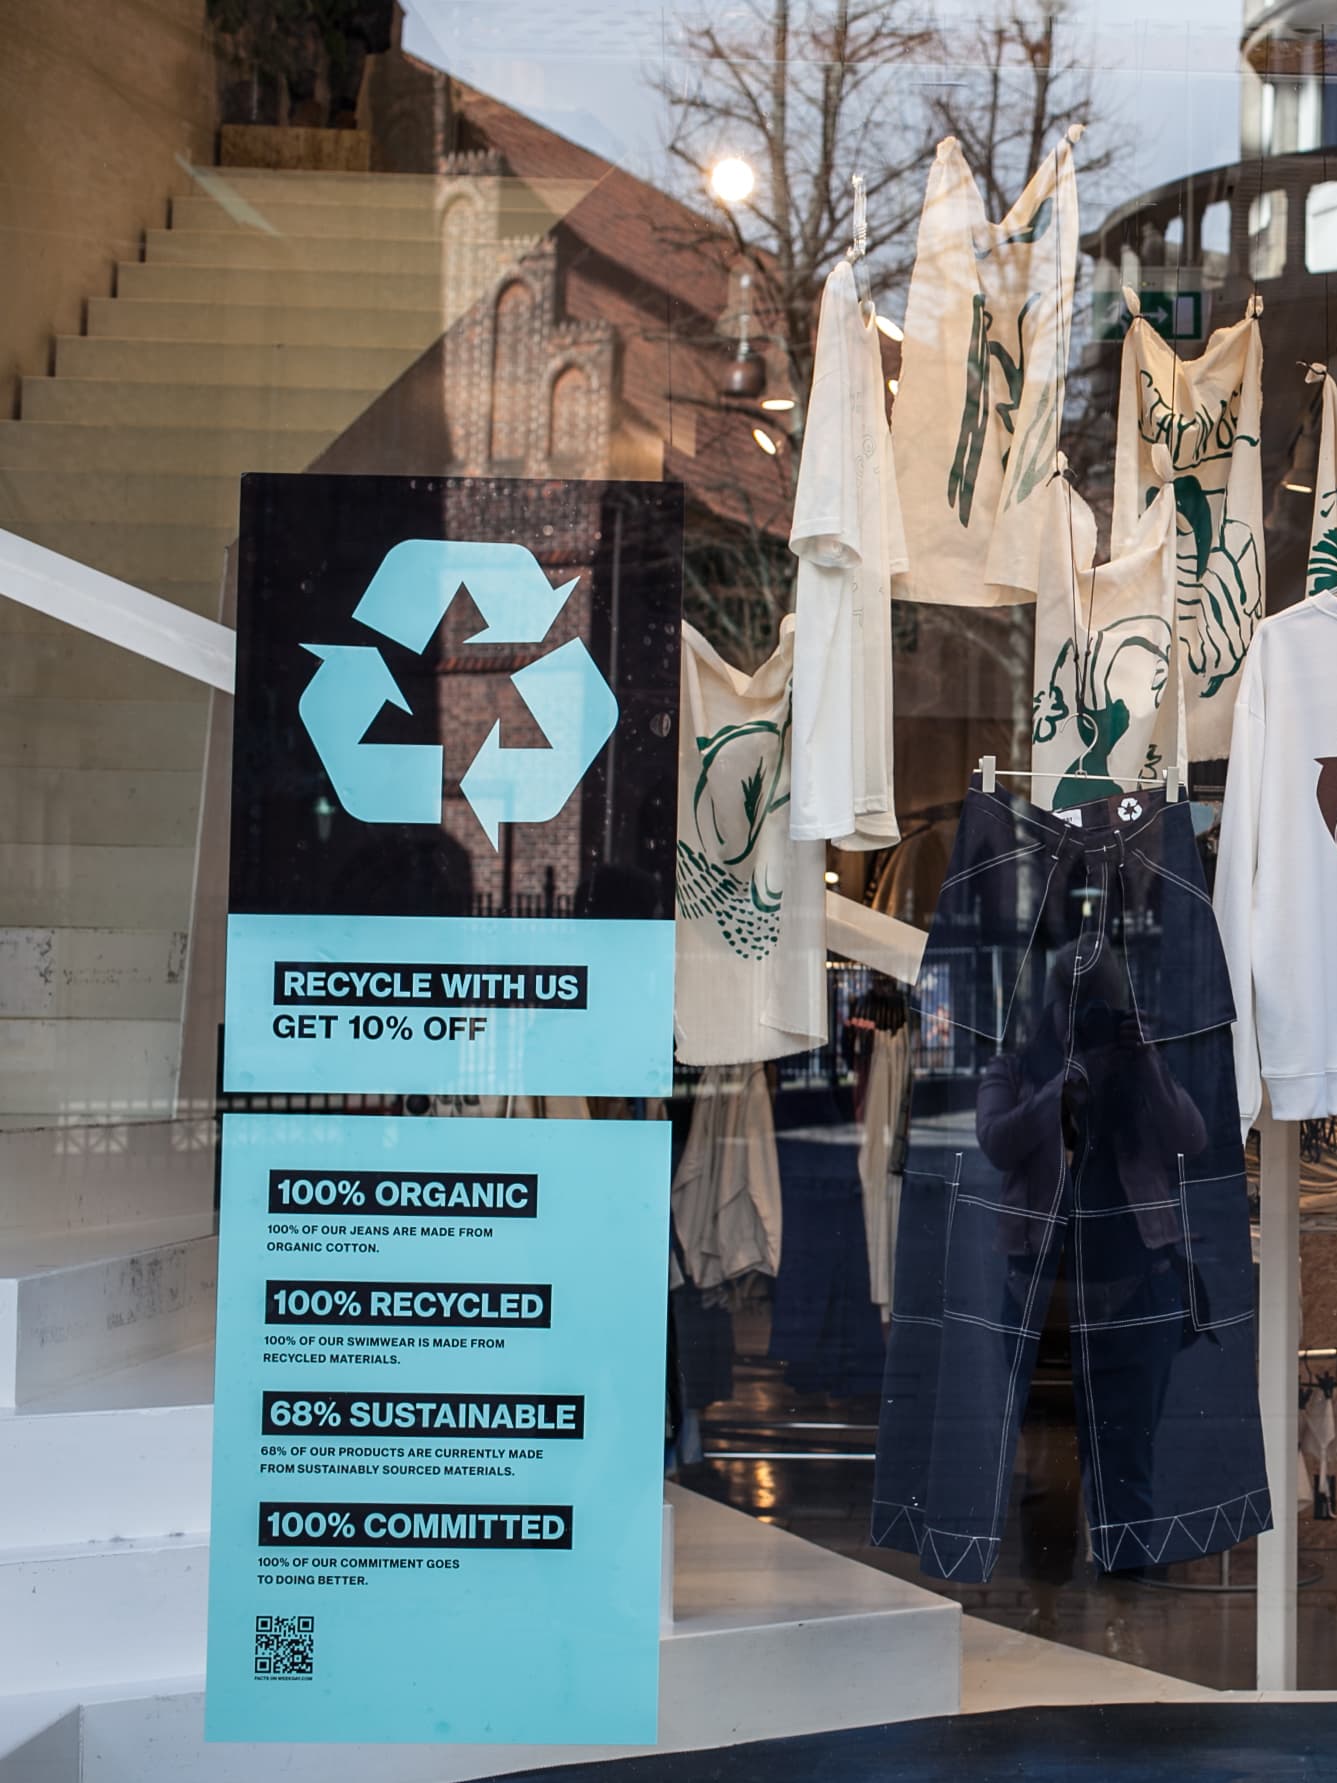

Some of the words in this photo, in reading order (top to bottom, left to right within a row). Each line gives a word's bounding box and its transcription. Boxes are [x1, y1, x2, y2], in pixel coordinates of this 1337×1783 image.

[284, 971, 431, 997] RECYCLE
[441, 974, 524, 999] WITH
[536, 975, 578, 1000] US
[273, 1015, 338, 1038] GET
[349, 1016, 412, 1040] 10%
[424, 1017, 487, 1040] OFF
[278, 1180, 365, 1205] 100%
[376, 1181, 528, 1208] ORGANIC
[267, 1224, 300, 1235] 100%
[301, 1224, 319, 1235] OF
[320, 1225, 347, 1236] OUR
[349, 1225, 390, 1236] JEANS
[392, 1226, 417, 1237] ARE
[420, 1226, 455, 1237] MADE
[458, 1227, 493, 1238] FROM
[266, 1241, 323, 1253] ORGANIC
[325, 1242, 380, 1253] COTTON.
[274, 1290, 361, 1316] 100%
[371, 1292, 543, 1318] RECYCLED
[264, 1335, 297, 1346] 100%
[298, 1335, 316, 1346] OF
[318, 1336, 344, 1346] OUR
[346, 1336, 416, 1348] SWIMWEAR
[418, 1337, 430, 1348] IS
[432, 1337, 468, 1348] MADE
[470, 1338, 505, 1349] FROM
[263, 1352, 327, 1364] RECYCLED
[329, 1353, 401, 1365] MATERIALS.
[271, 1401, 341, 1426] 68%
[350, 1402, 576, 1429] SUSTAINABLE
[260, 1445, 287, 1457] 68%
[290, 1446, 307, 1457] OF
[309, 1446, 336, 1457] OUR
[338, 1446, 405, 1458] PRODUCTS
[407, 1447, 433, 1458] ARE
[434, 1448, 506, 1459] CURRENTLY
[508, 1449, 544, 1460] MADE
[259, 1463, 295, 1474] FROM
[297, 1463, 380, 1475] SUSTAINABLY
[382, 1464, 441, 1476] SOURCED
[443, 1465, 515, 1477] MATERIALS.
[268, 1512, 355, 1537] 100%
[364, 1513, 564, 1539] COMMITTED
[257, 1557, 290, 1568] 100%
[292, 1557, 309, 1568] OF
[311, 1557, 338, 1568] OUR
[340, 1557, 424, 1569] COMMITMENT
[426, 1559, 460, 1569] GOES
[256, 1574, 274, 1585] TO
[275, 1575, 315, 1585] DOING
[317, 1575, 369, 1586] BETTER.
